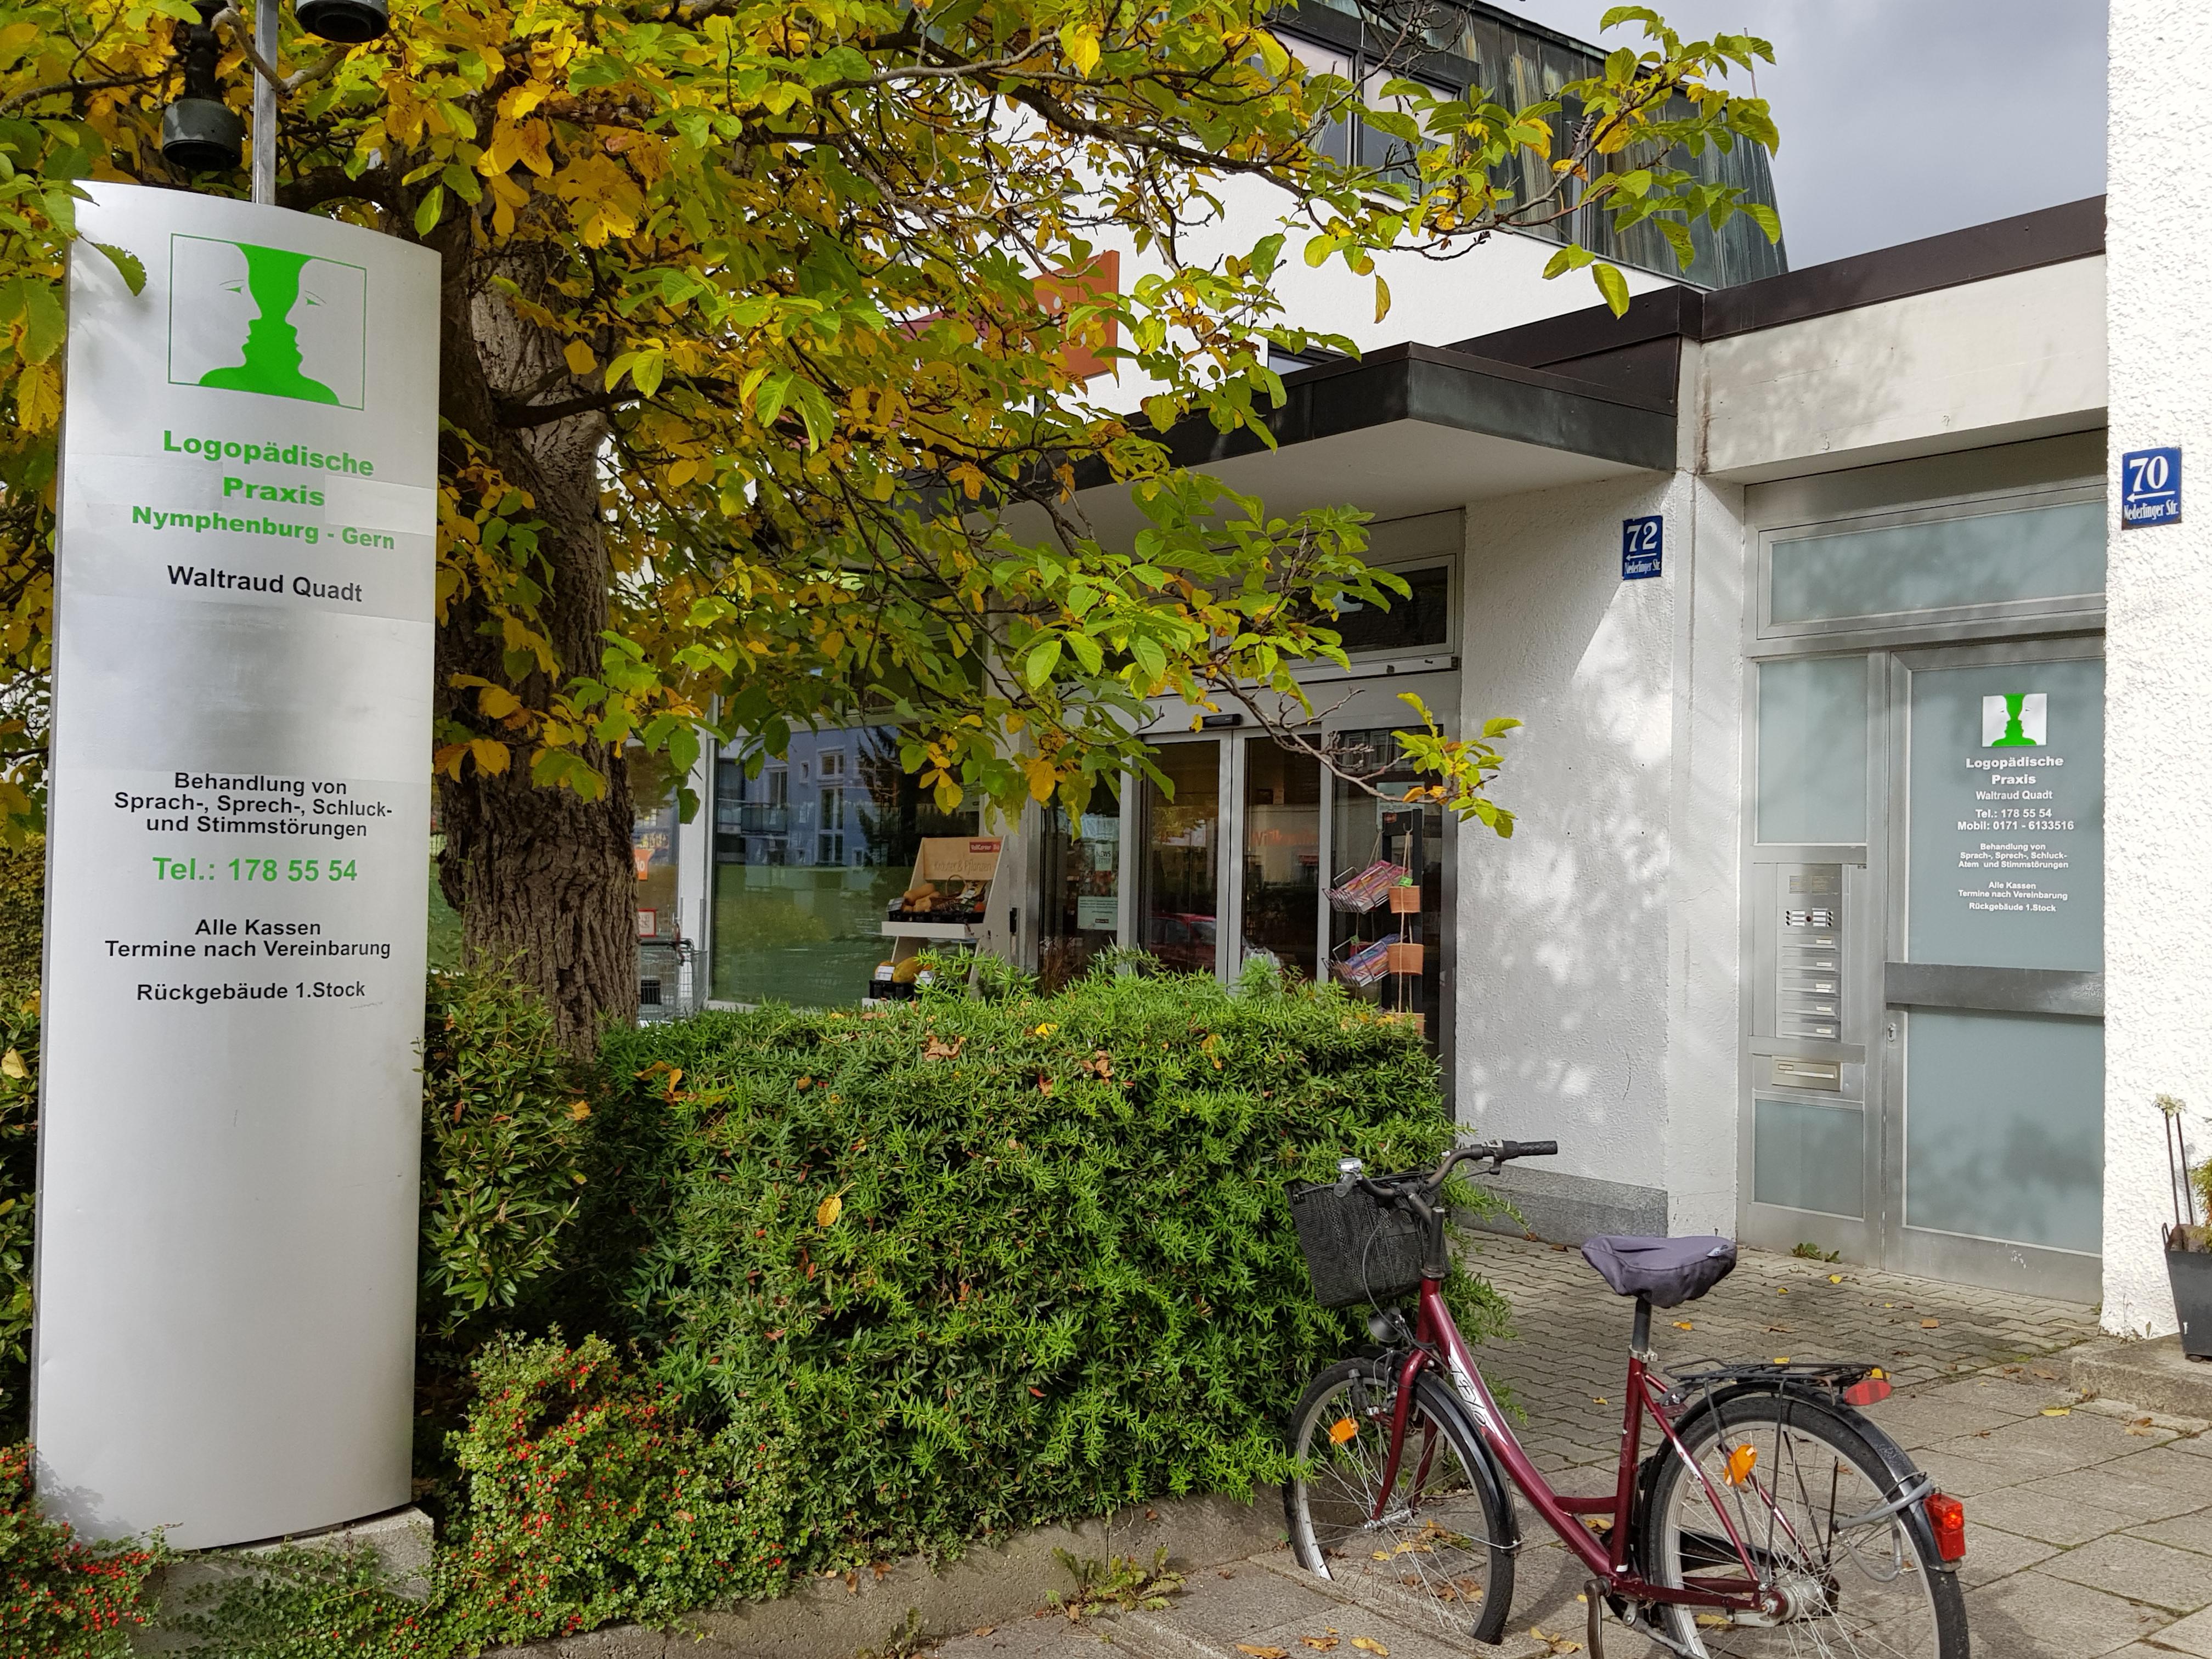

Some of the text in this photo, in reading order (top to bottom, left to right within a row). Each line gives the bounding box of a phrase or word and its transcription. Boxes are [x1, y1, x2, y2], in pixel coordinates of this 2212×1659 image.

[163, 430, 374, 477] Logopädische
[2129, 456, 2169, 492] 70
[222, 476, 325, 507] Praxis
[132, 506, 319, 545] Nymphenburg
[341, 527, 395, 550] Gern
[1627, 521, 1657, 552] 72
[167, 565, 363, 602] Waltraud Quadt
[1966, 756, 2064, 770] Logopädische
[174, 772, 347, 795] Behandlung von
[1991, 774, 2036, 785] Praxis
[114, 792, 392, 817] Sprach-, Sprech-, Schluck-
[1976, 790, 2053, 800] Waltraud Quadt
[1975, 808, 2052, 819] Tel.: 178 55 54
[146, 815, 367, 840] und Stimmstörungen
[1957, 821, 1990, 831] Mobil:
[1993, 821, 2018, 831] 0171
[2028, 820, 2074, 831] 6133516
[1960, 852, 1993, 860] Sprach-,
[1995, 852, 2029, 861] Sprech-,
[1980, 843, 2028, 851] Behandlung
[151, 856, 358, 882] Tel.: 178 55 54
[2001, 861, 2069, 870] Stimmstörungen
[1958, 889, 1990, 898] Termine
[2013, 890, 2068, 900] Vereinbarung
[1969, 902, 2023, 912] Rückgebäude
[195, 919, 321, 936] Alle Kassen
[105, 940, 391, 959] Termine nach Vereinbarung
[137, 980, 366, 1005] Rückgebäude 1.Stock
